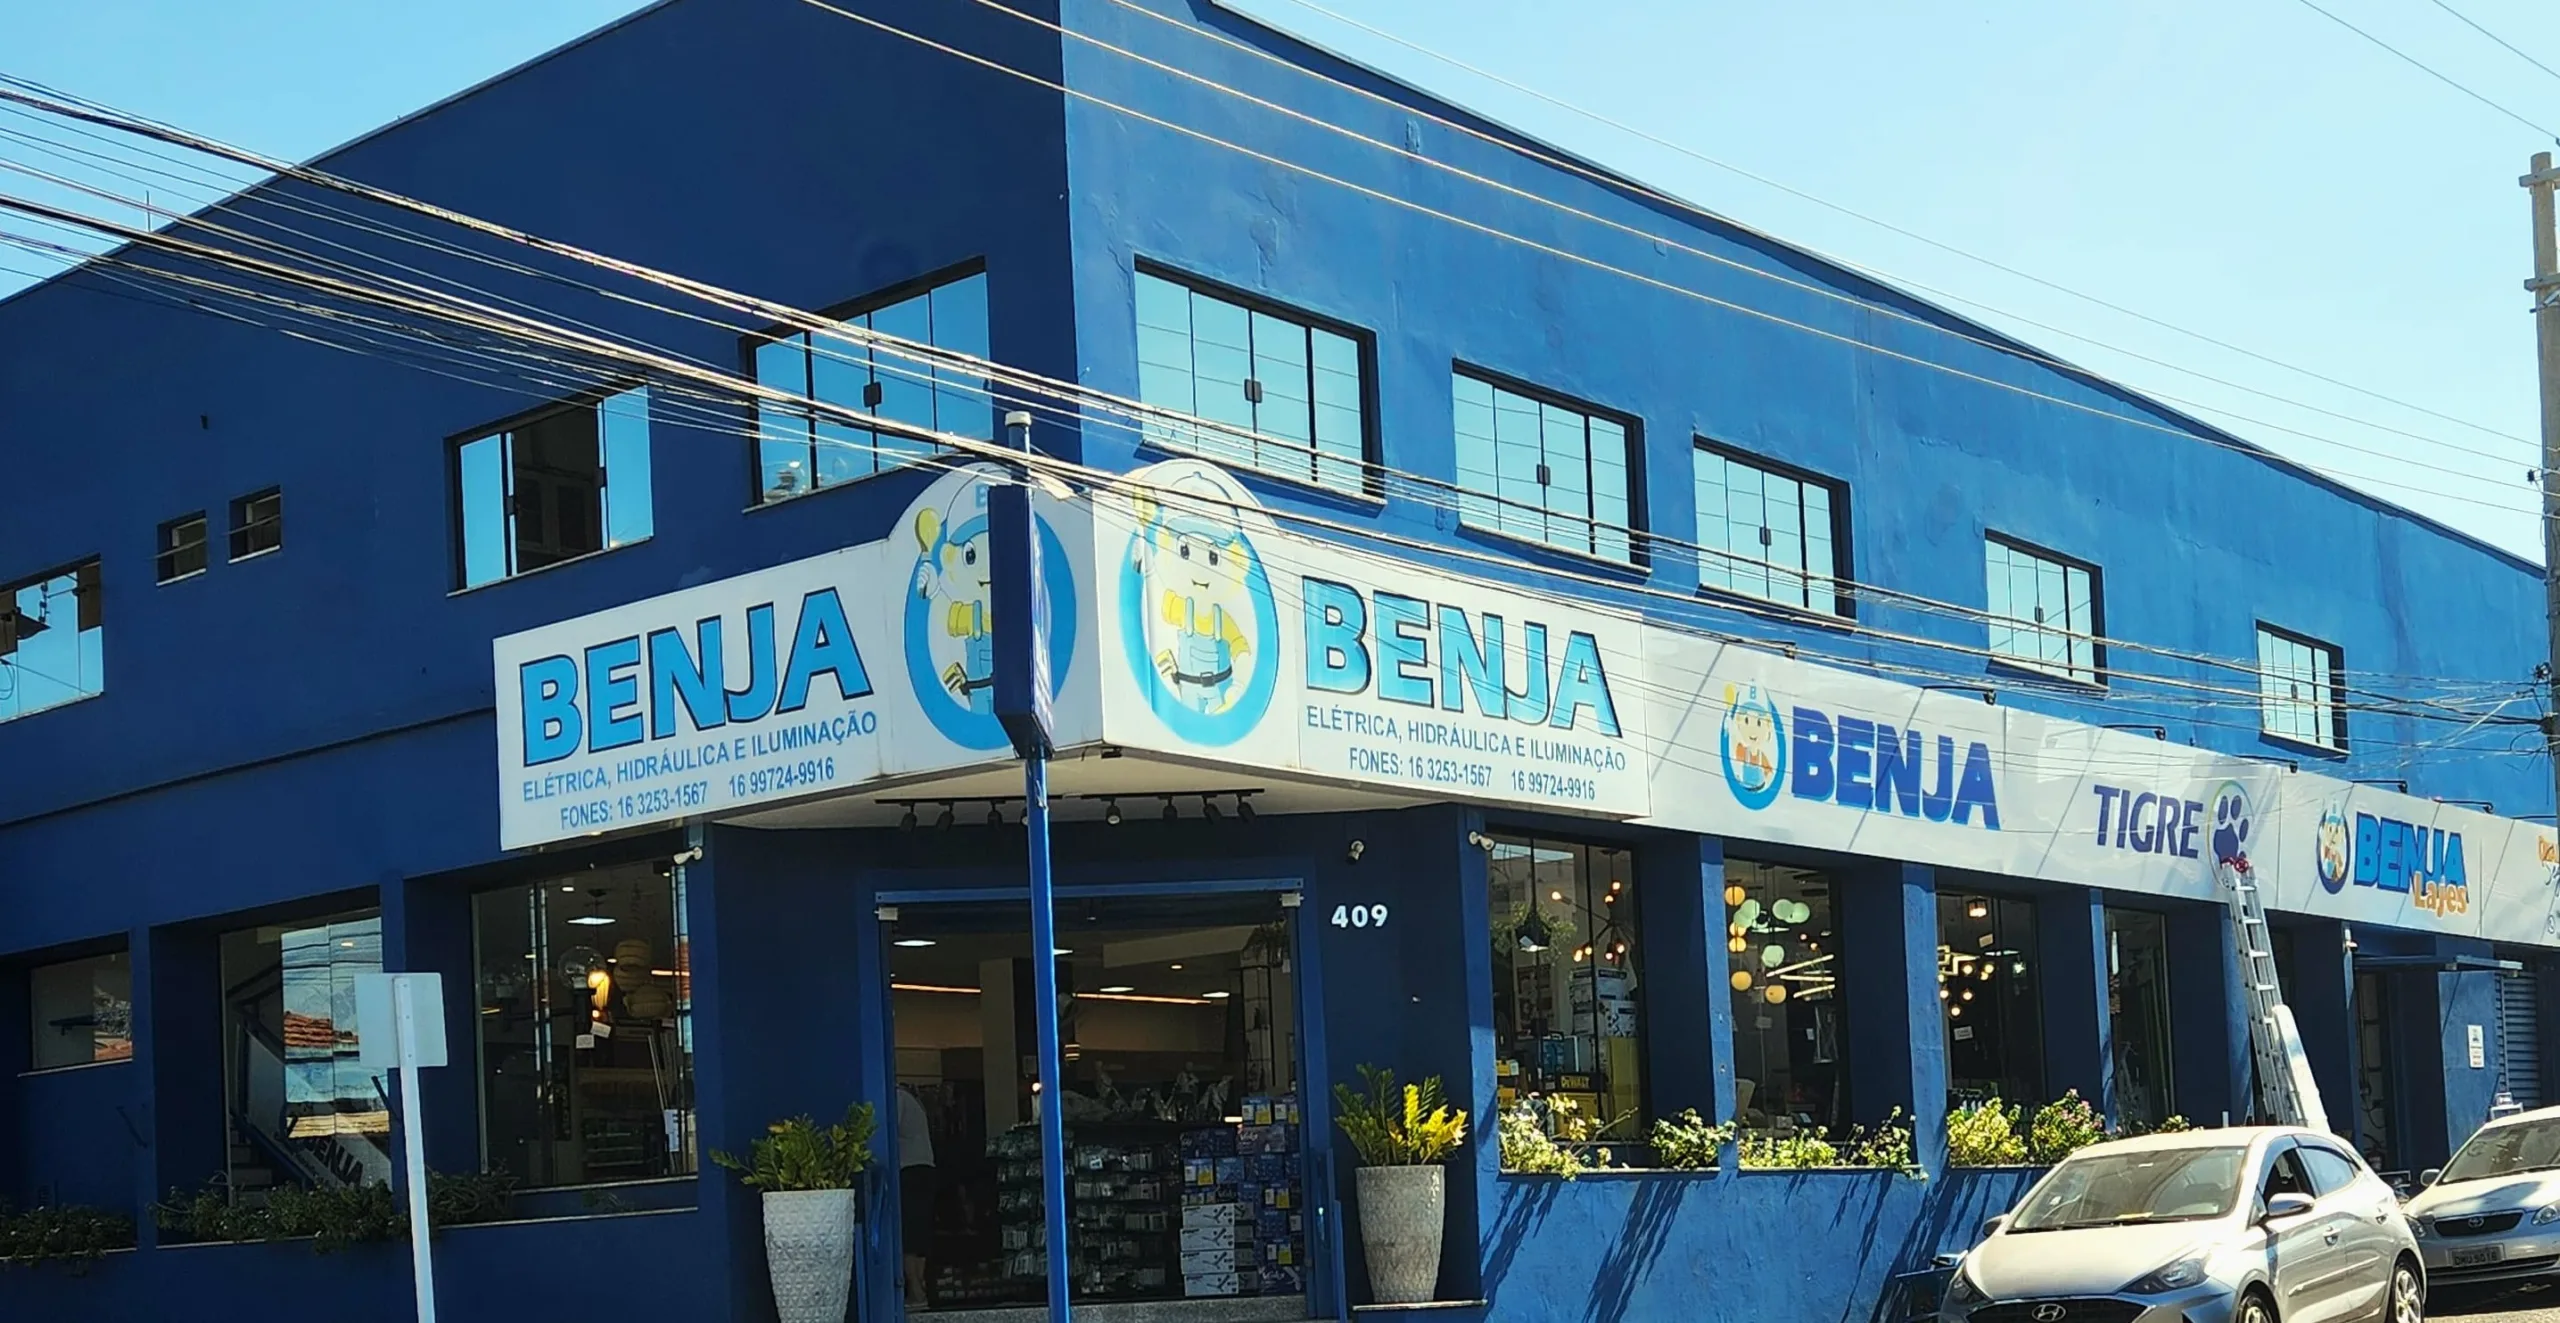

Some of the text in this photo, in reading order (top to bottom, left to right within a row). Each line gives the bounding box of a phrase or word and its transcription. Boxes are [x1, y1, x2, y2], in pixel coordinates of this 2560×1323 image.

[519, 587, 873, 768] BENJA
[1302, 575, 1622, 738] BENJA
[522, 710, 877, 802] ELÉTRICA, HIDRÁULICA E ILUMINAÇÃO
[1307, 704, 1627, 773] ELÉTRICA, HIDRÁULICA E ILUMINAÇÃO
[1349, 748, 1596, 801] FONES: 16 3253-1567 16 99724-9916
[1791, 705, 2001, 831] BENJA
[560, 756, 835, 830] FONES: 16 3253-1567 16 99724-9916
[2093, 784, 2204, 860] TIGRE
[2352, 811, 2470, 904] BENJA
[2413, 872, 2469, 918] Lajes
[1331, 904, 1388, 928] 409
